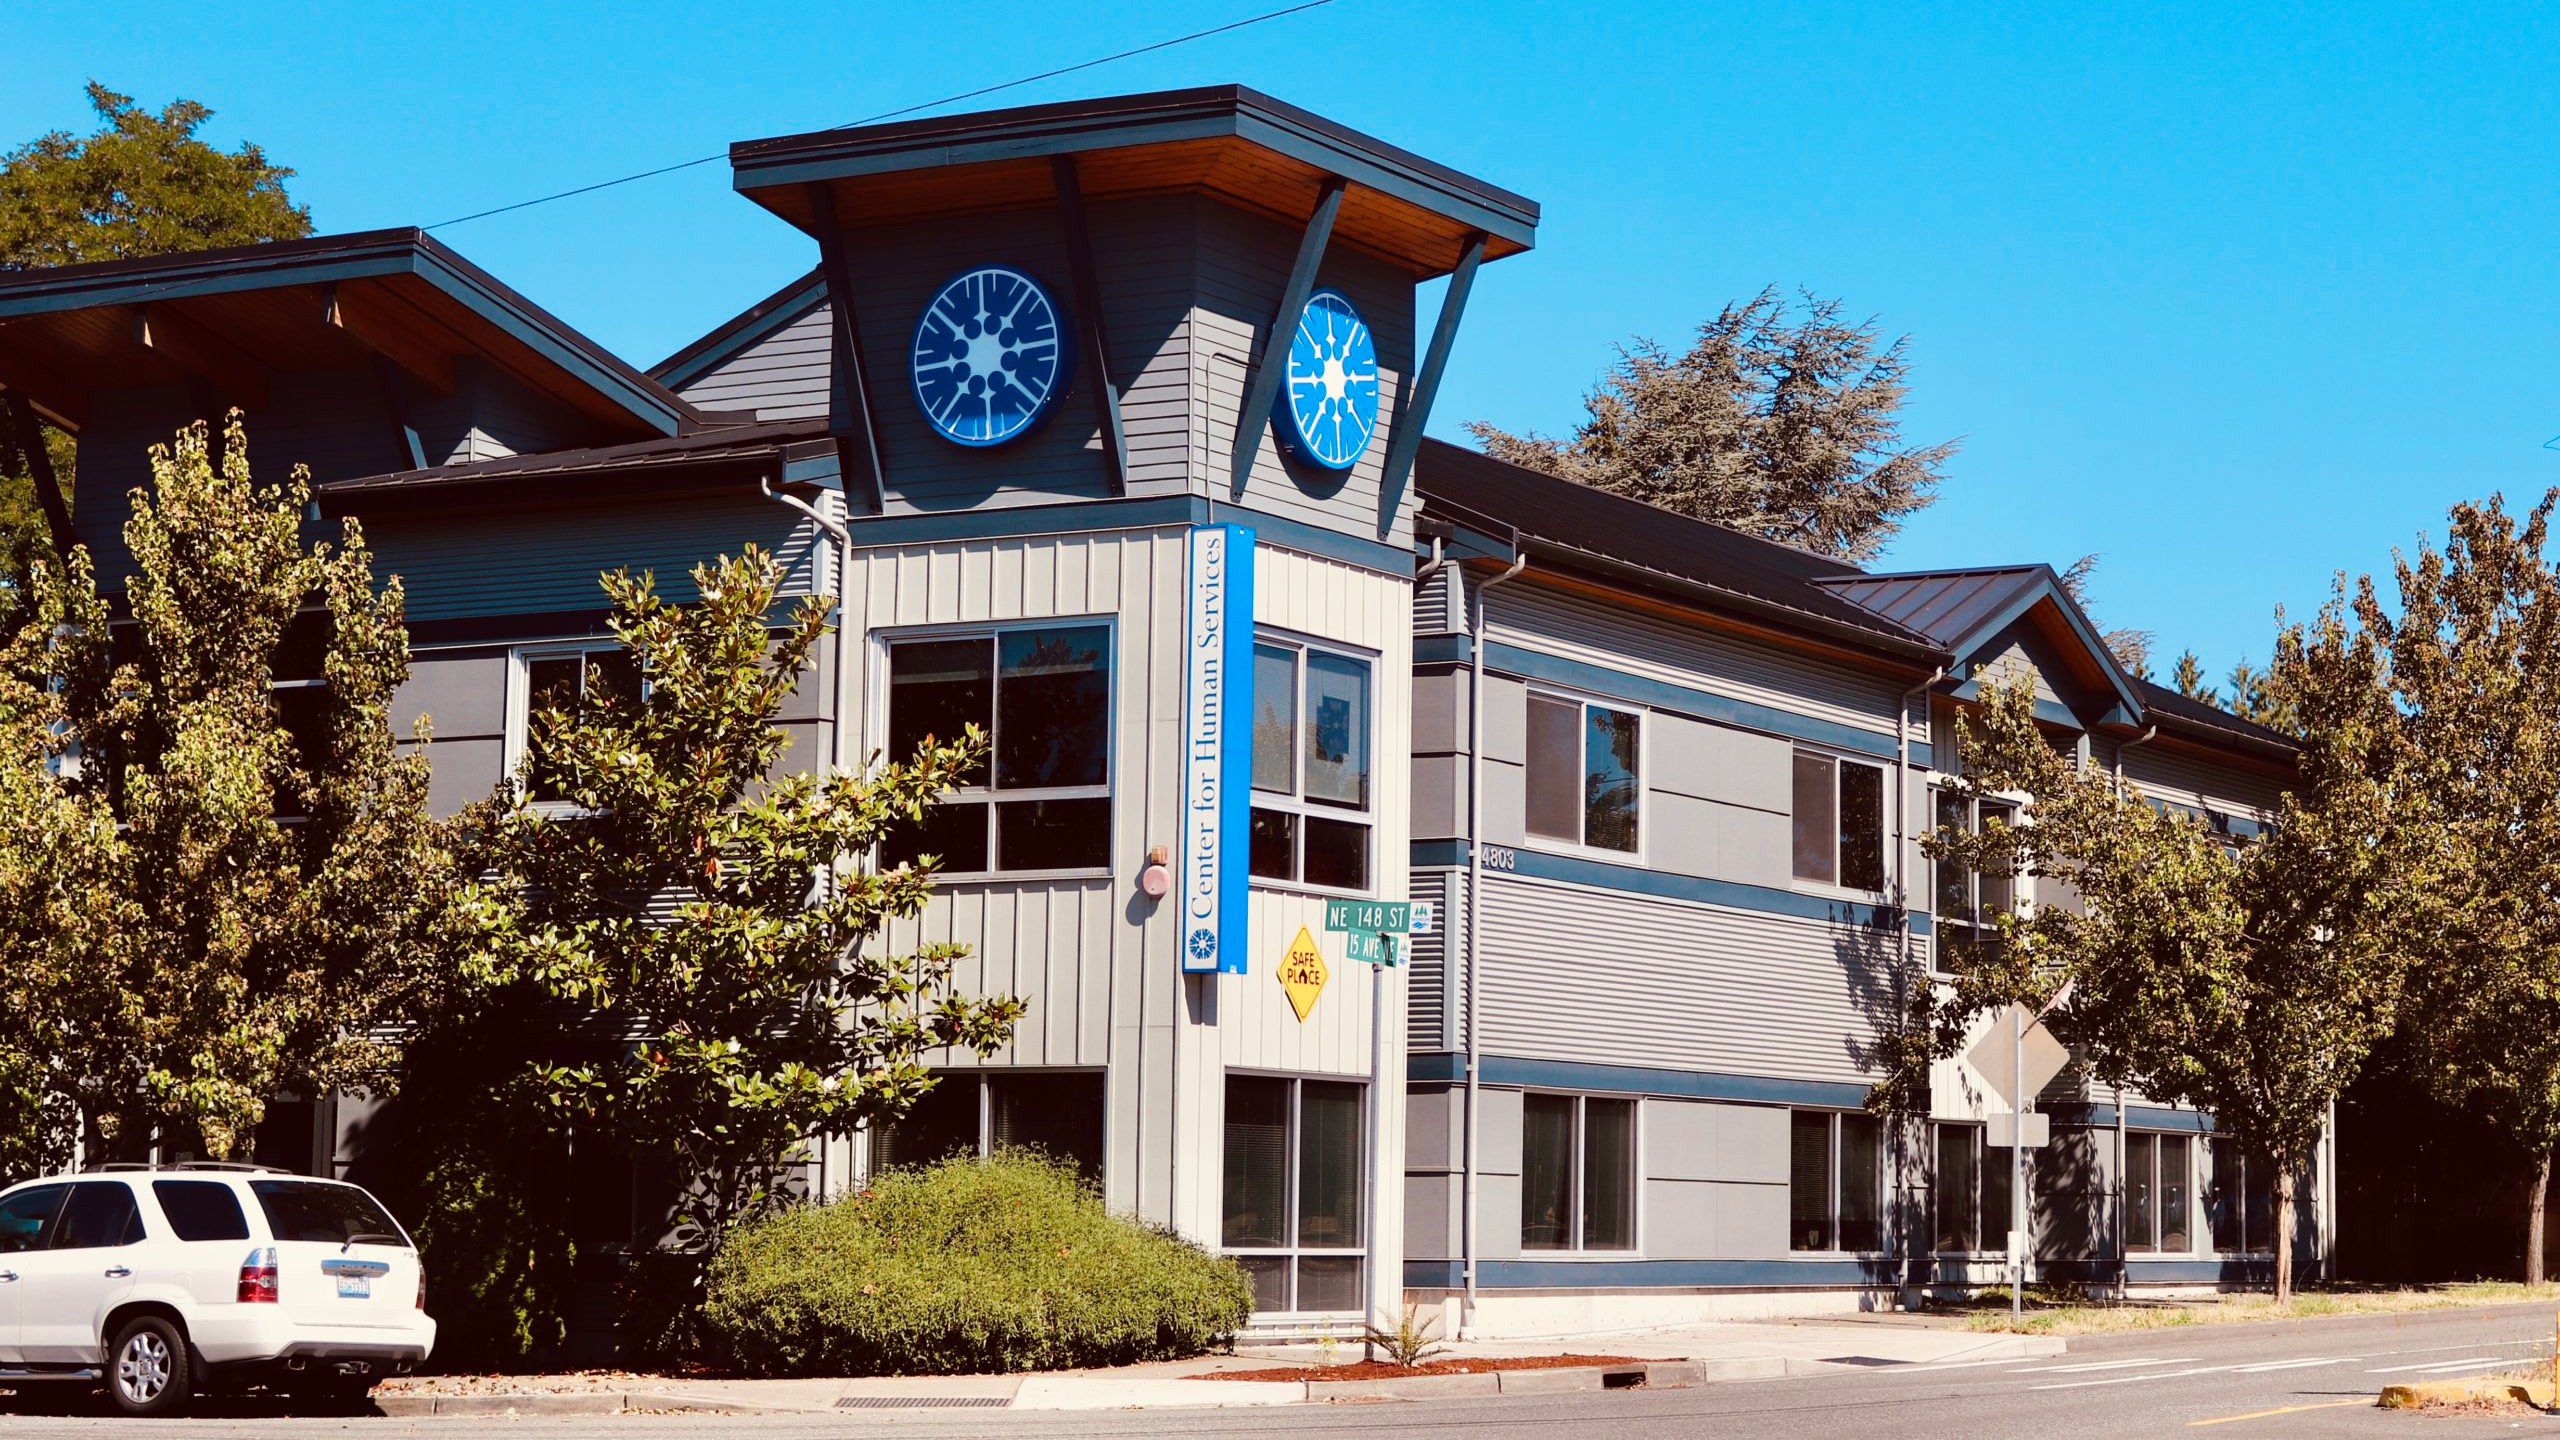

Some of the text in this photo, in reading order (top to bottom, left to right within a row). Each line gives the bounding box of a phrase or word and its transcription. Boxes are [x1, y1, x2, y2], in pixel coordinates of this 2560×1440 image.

[1191, 537, 1221, 919] Center for Human Services
[1330, 906, 1405, 928] NE 148 ST
[1349, 933, 1359, 955] 15
[1362, 936, 1380, 959] AVE
[1292, 951, 1315, 968] SAFE
[1287, 967, 1320, 986] PLACE
